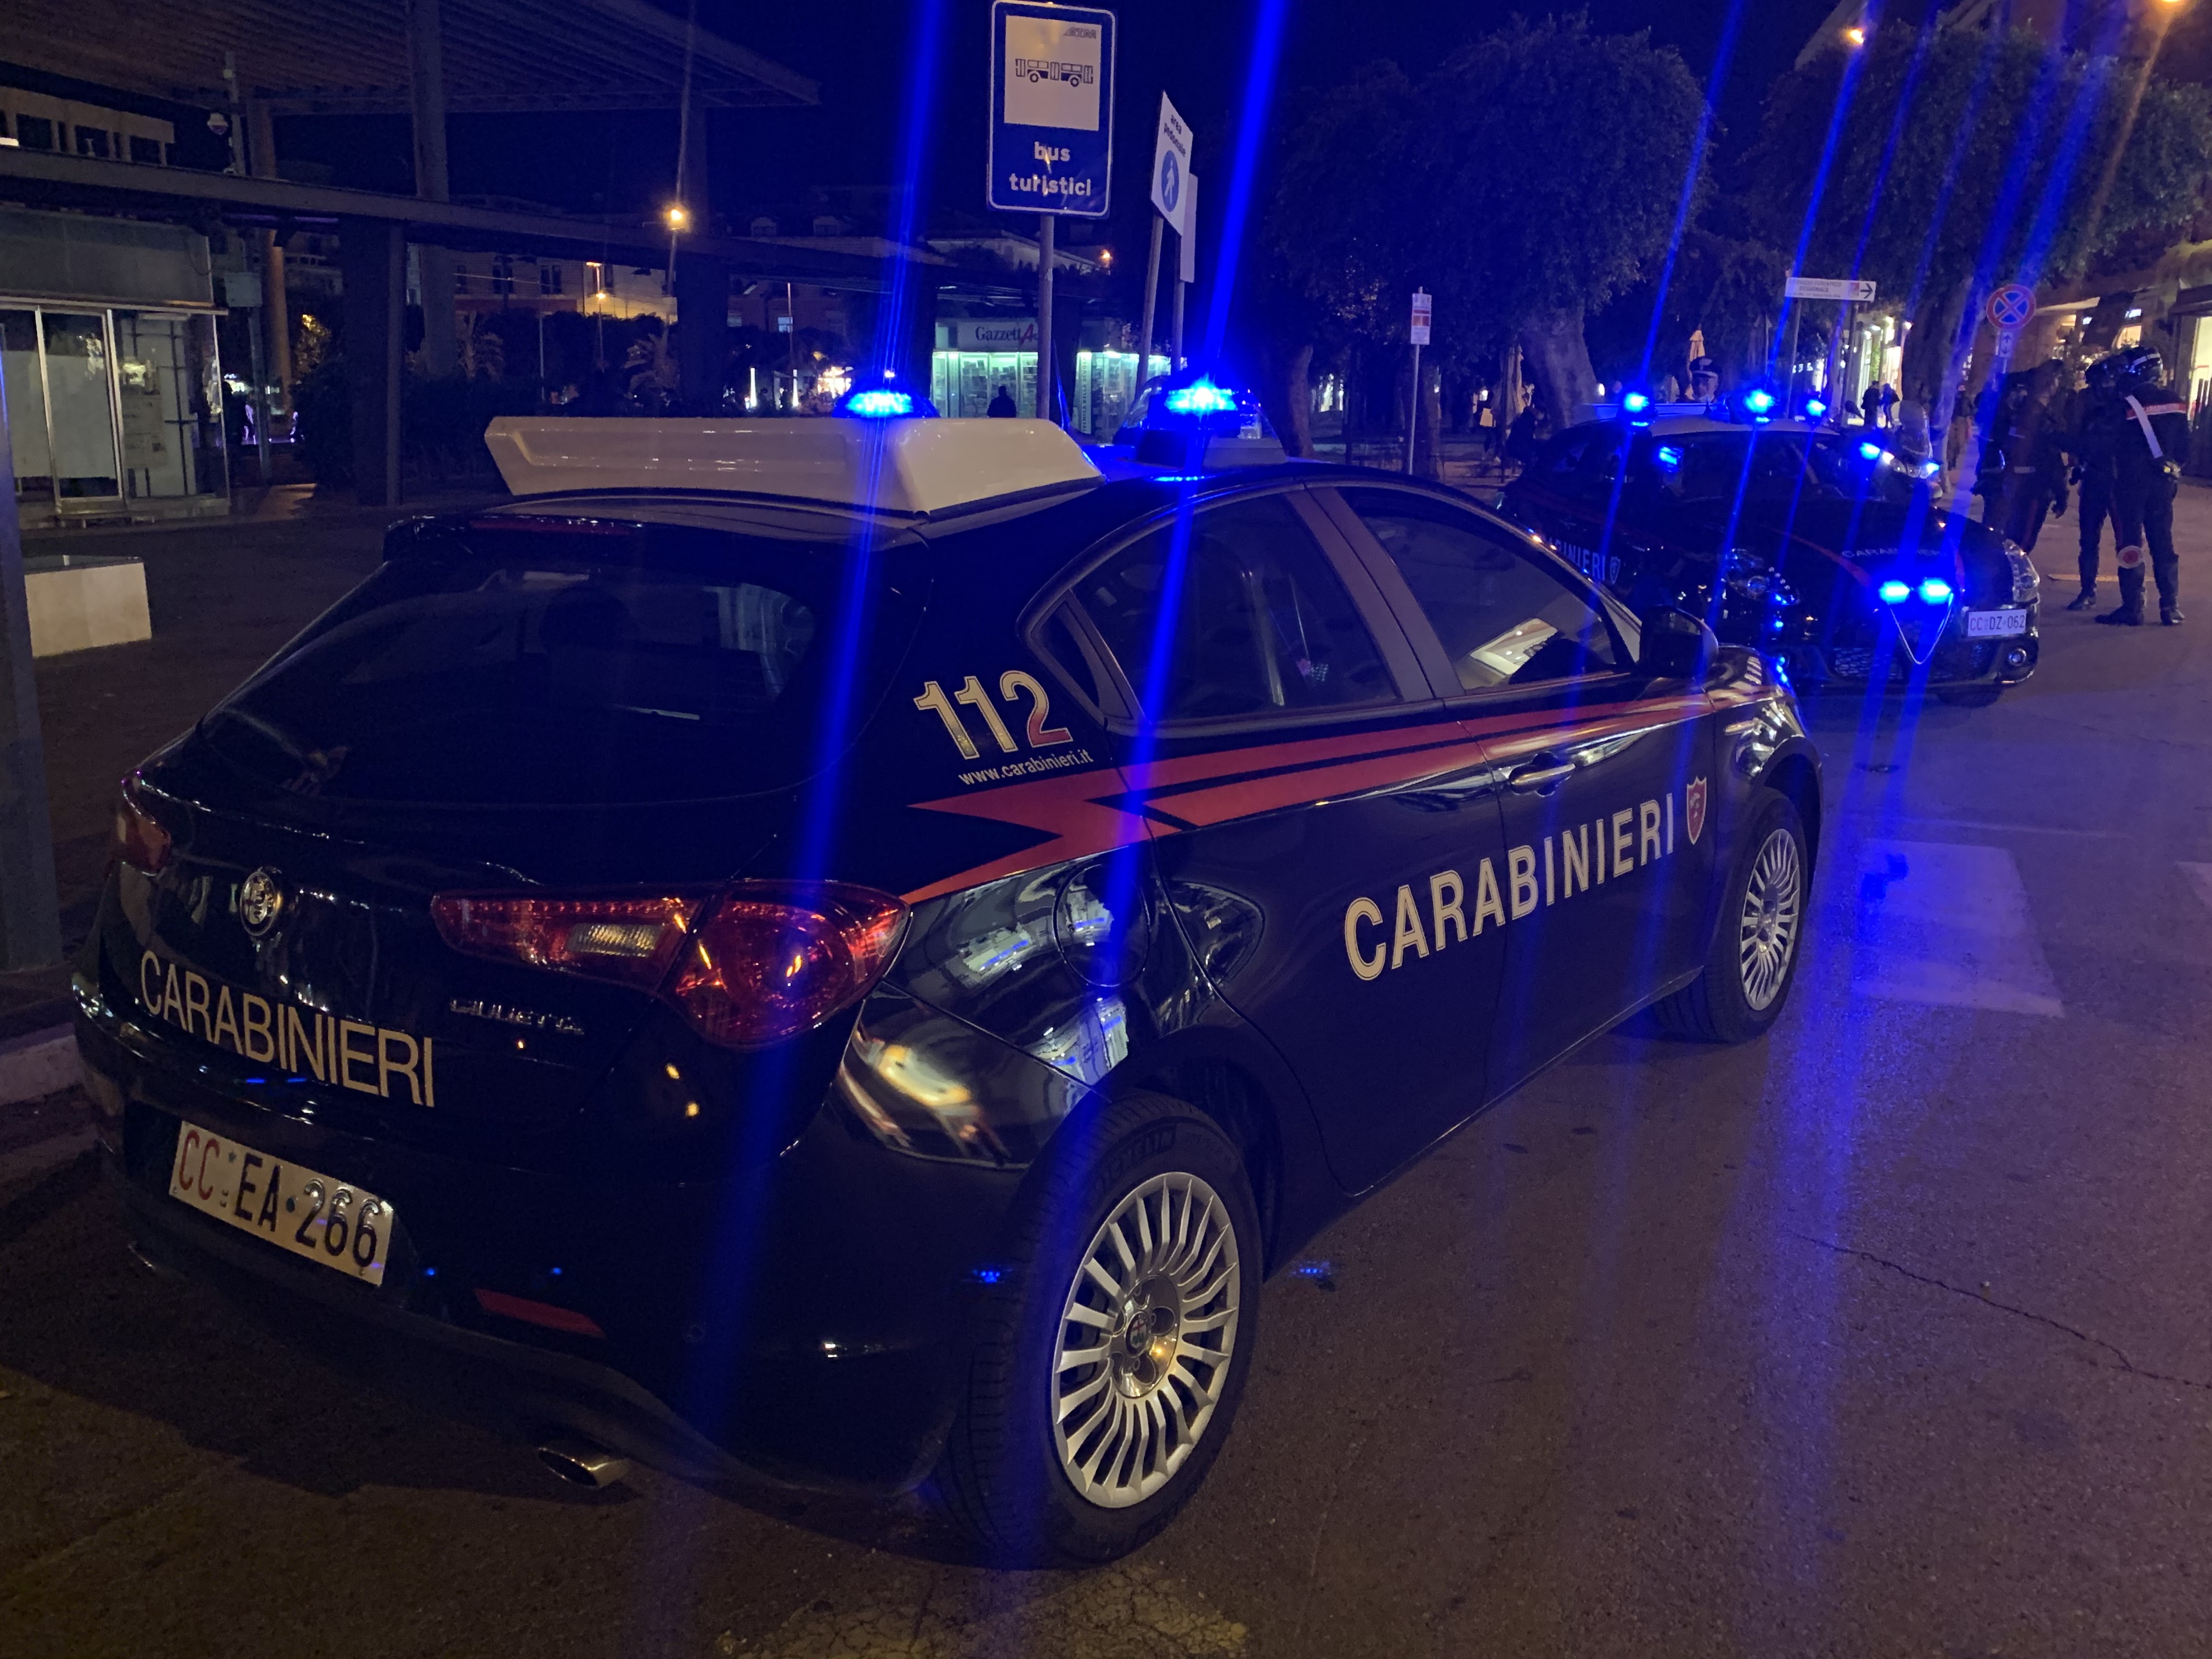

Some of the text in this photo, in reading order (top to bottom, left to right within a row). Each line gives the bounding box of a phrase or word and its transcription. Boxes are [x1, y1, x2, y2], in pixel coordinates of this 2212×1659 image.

[1034, 142, 1070, 162] bus
[1009, 172, 1092, 196] turistici
[1970, 614, 2025, 631] CC DZ 062
[913, 670, 1073, 759] 112
[958, 748, 1094, 785] www.carabinieri.it
[1345, 793, 1674, 981] CARABINIERI
[141, 950, 435, 1108] CARABINIERI
[178, 1129, 383, 1267] CC EA 266
